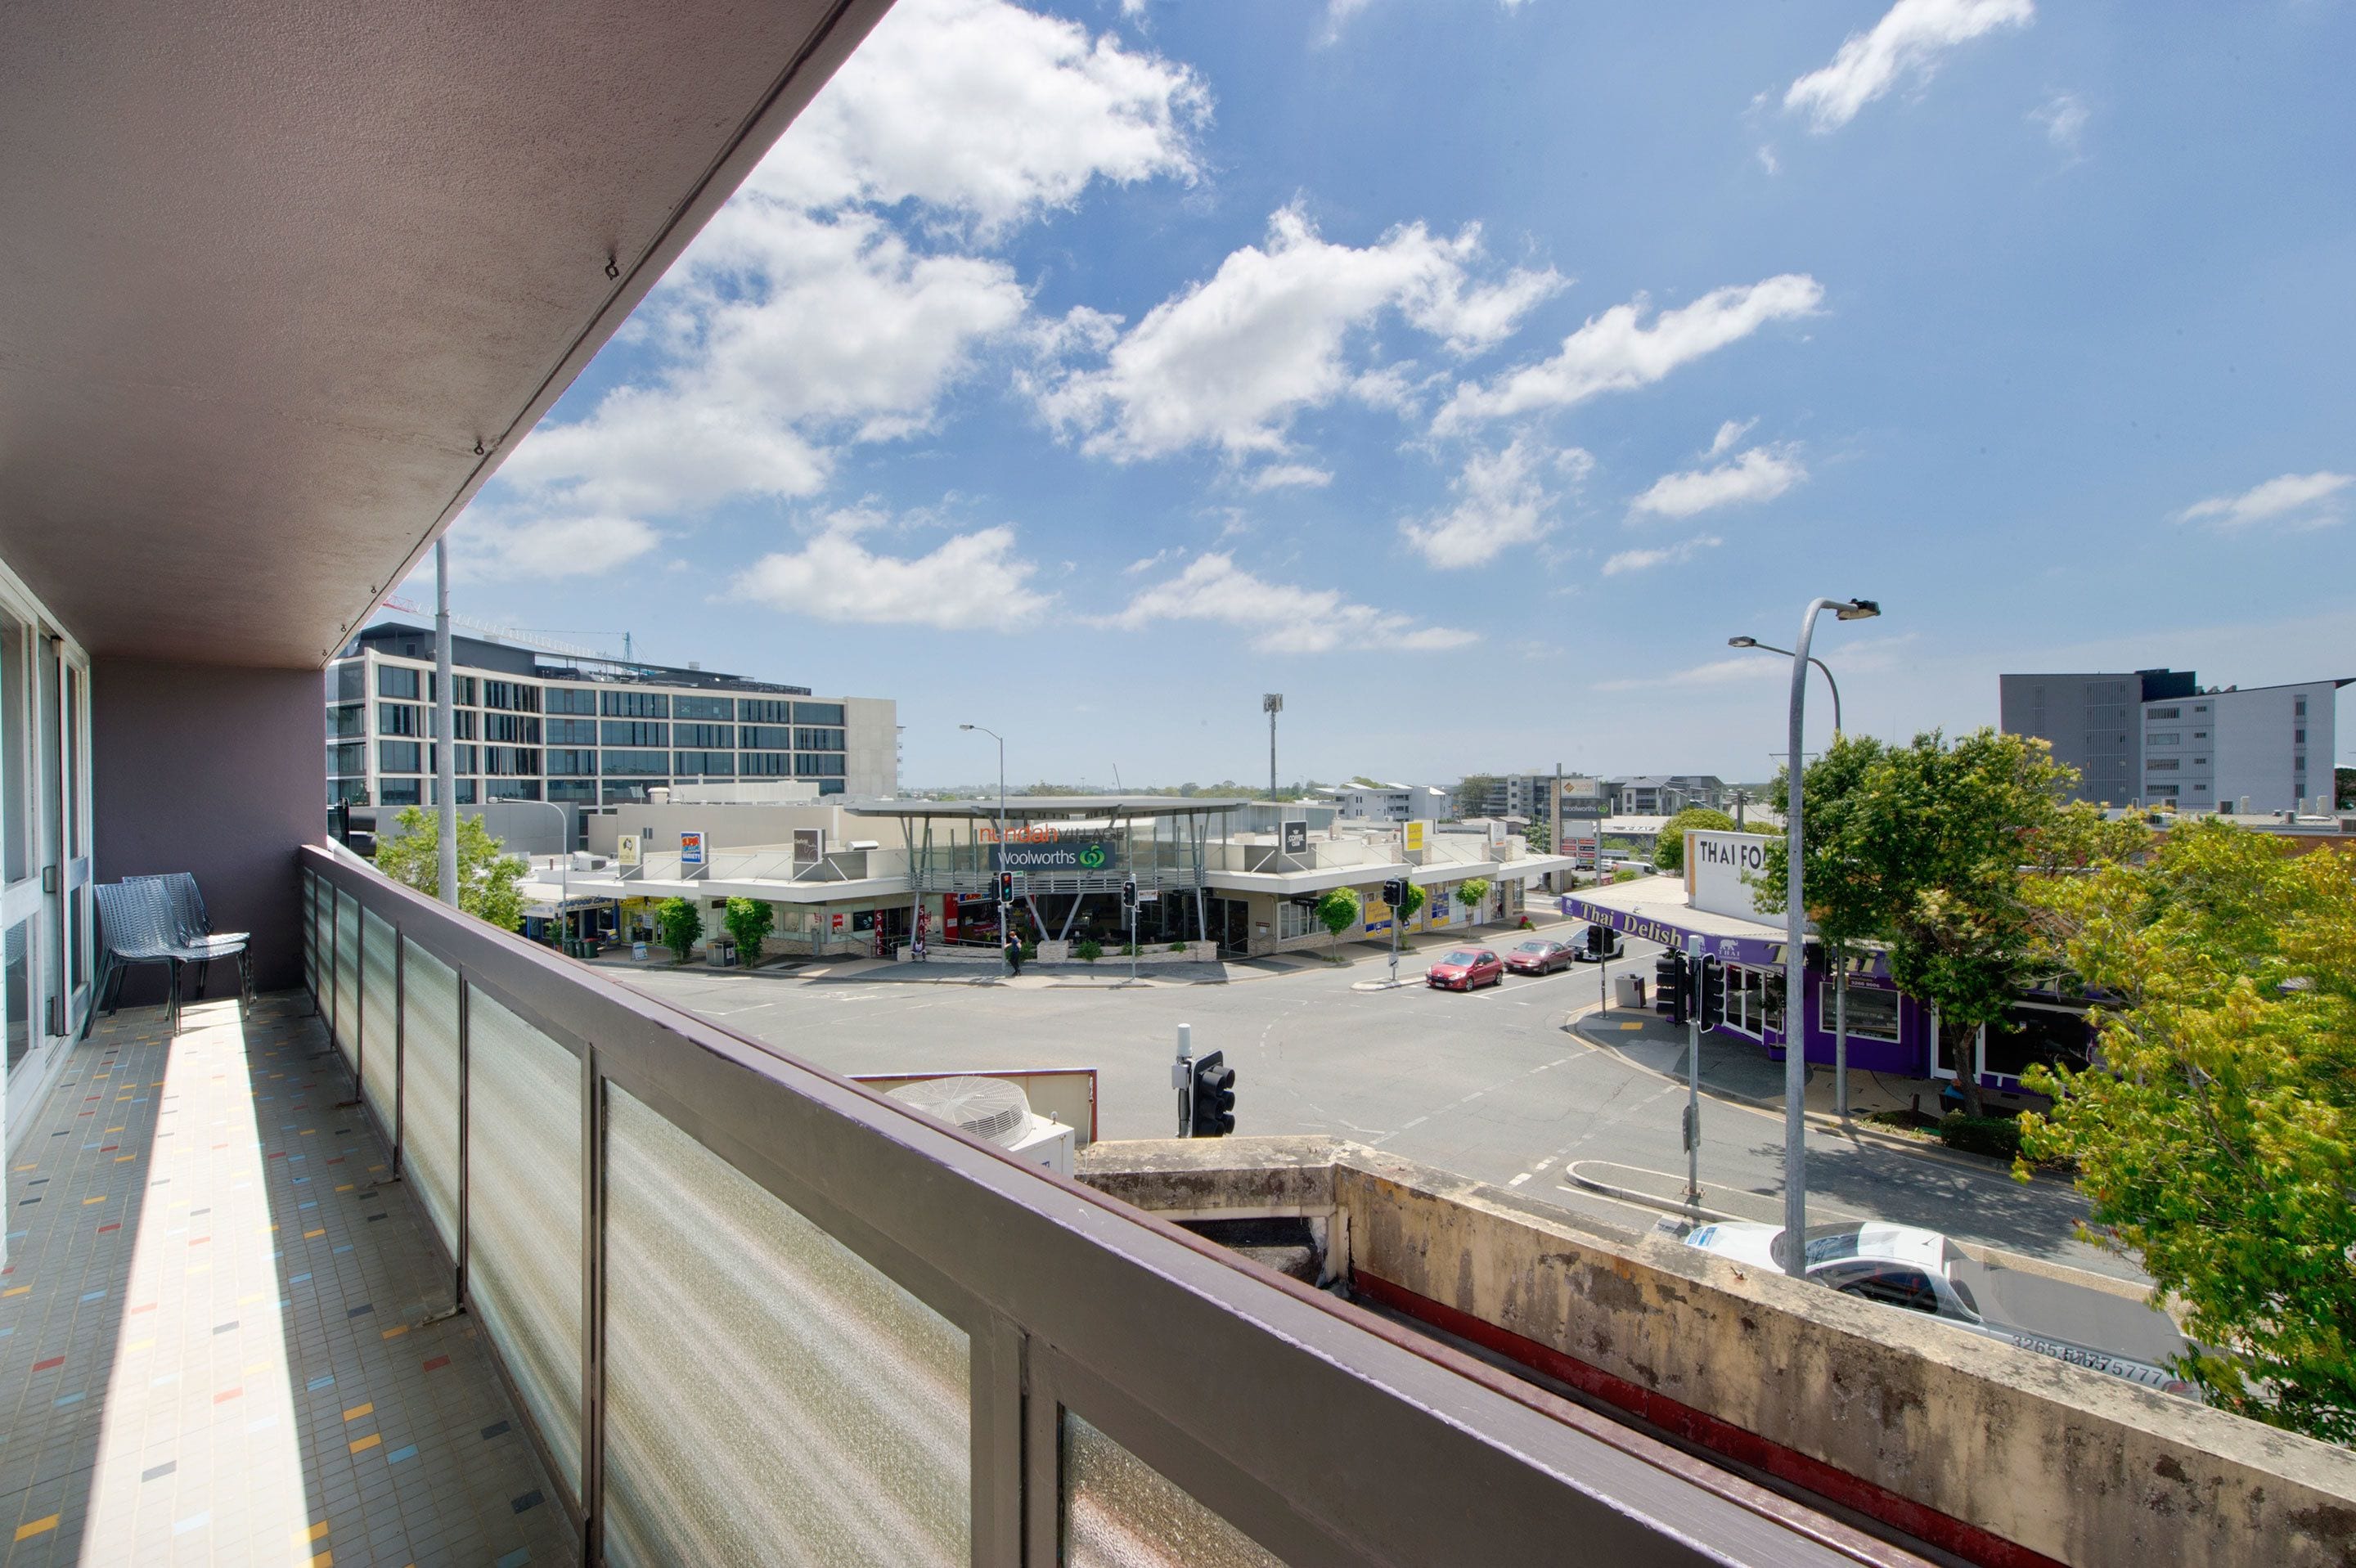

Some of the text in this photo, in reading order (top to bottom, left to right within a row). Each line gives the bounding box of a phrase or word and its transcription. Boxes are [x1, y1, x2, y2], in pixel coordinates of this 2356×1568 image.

[979, 824, 1125, 842] nundah VILLAGE
[998, 850, 1076, 865] Woolworths
[1700, 841, 1767, 869] THAI FO
[1580, 902, 1683, 948] Thai Delish
